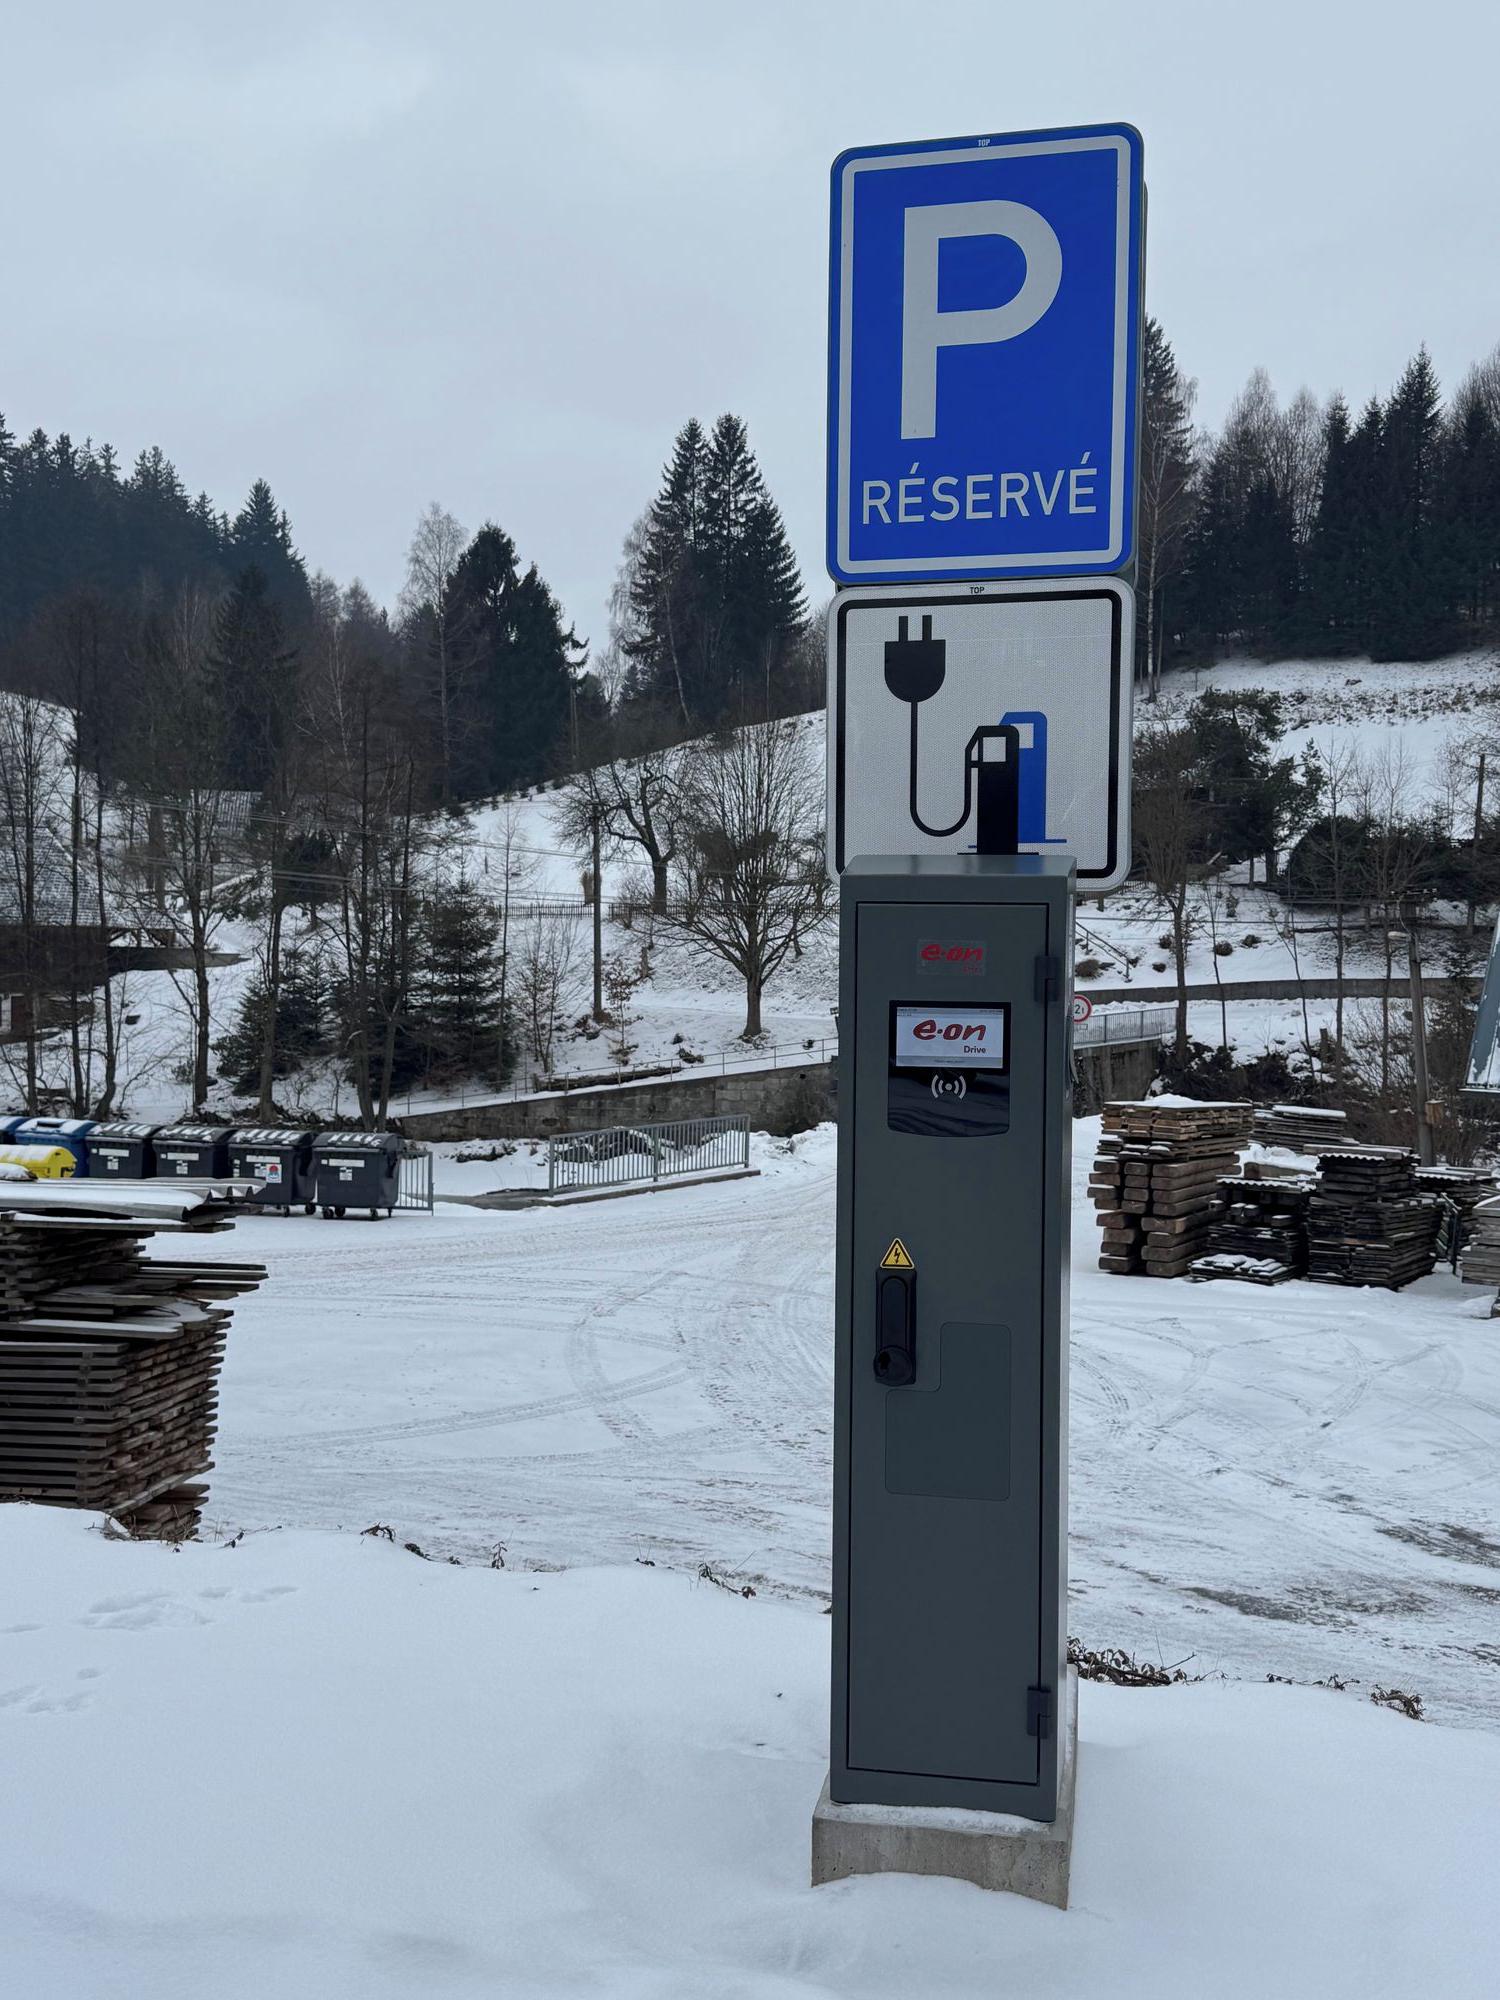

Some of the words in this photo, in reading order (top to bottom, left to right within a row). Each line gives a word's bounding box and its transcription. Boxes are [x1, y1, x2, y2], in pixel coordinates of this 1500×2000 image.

[901, 200, 1063, 440] P
[862, 452, 1098, 525] RÉSERVÉ
[970, 586, 985, 594] TOP
[963, 1045, 987, 1054] Drive
